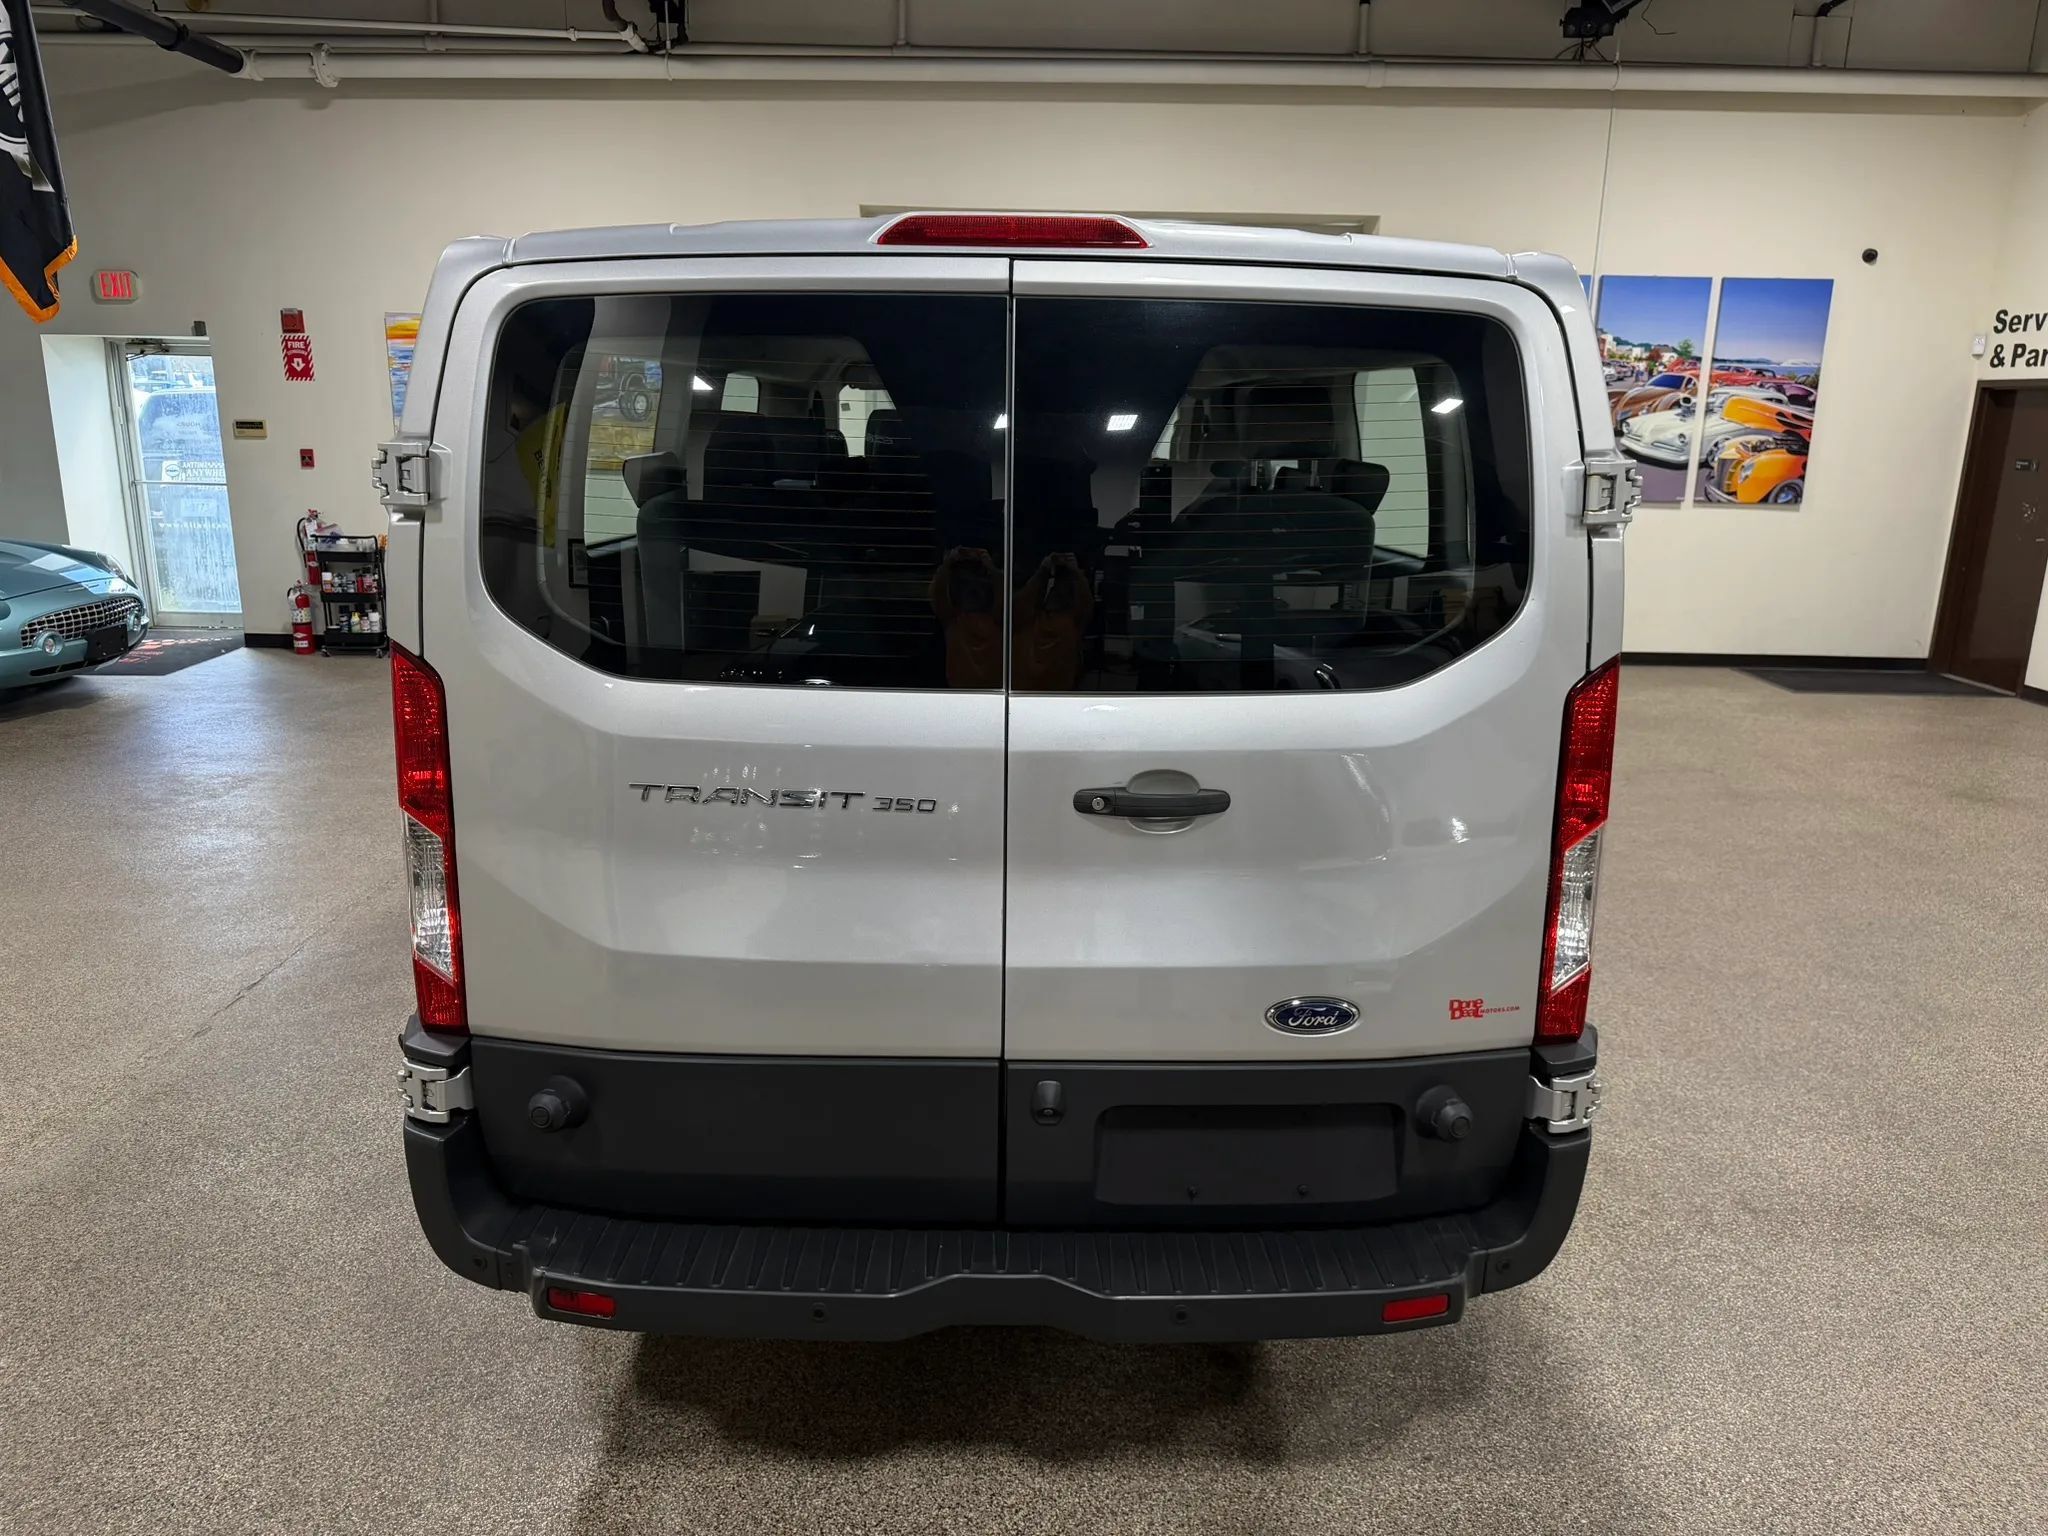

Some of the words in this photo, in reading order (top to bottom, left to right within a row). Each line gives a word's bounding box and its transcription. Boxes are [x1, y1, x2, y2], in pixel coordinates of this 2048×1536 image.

[100, 271, 132, 298] EXIT
[1993, 309, 2048, 334] Serv
[287, 341, 306, 349] FIRE
[1989, 344, 2006, 368] &
[628, 782, 866, 809] TRANSIT
[872, 797, 937, 812] 350
[1288, 1006, 1338, 1027] Ford
